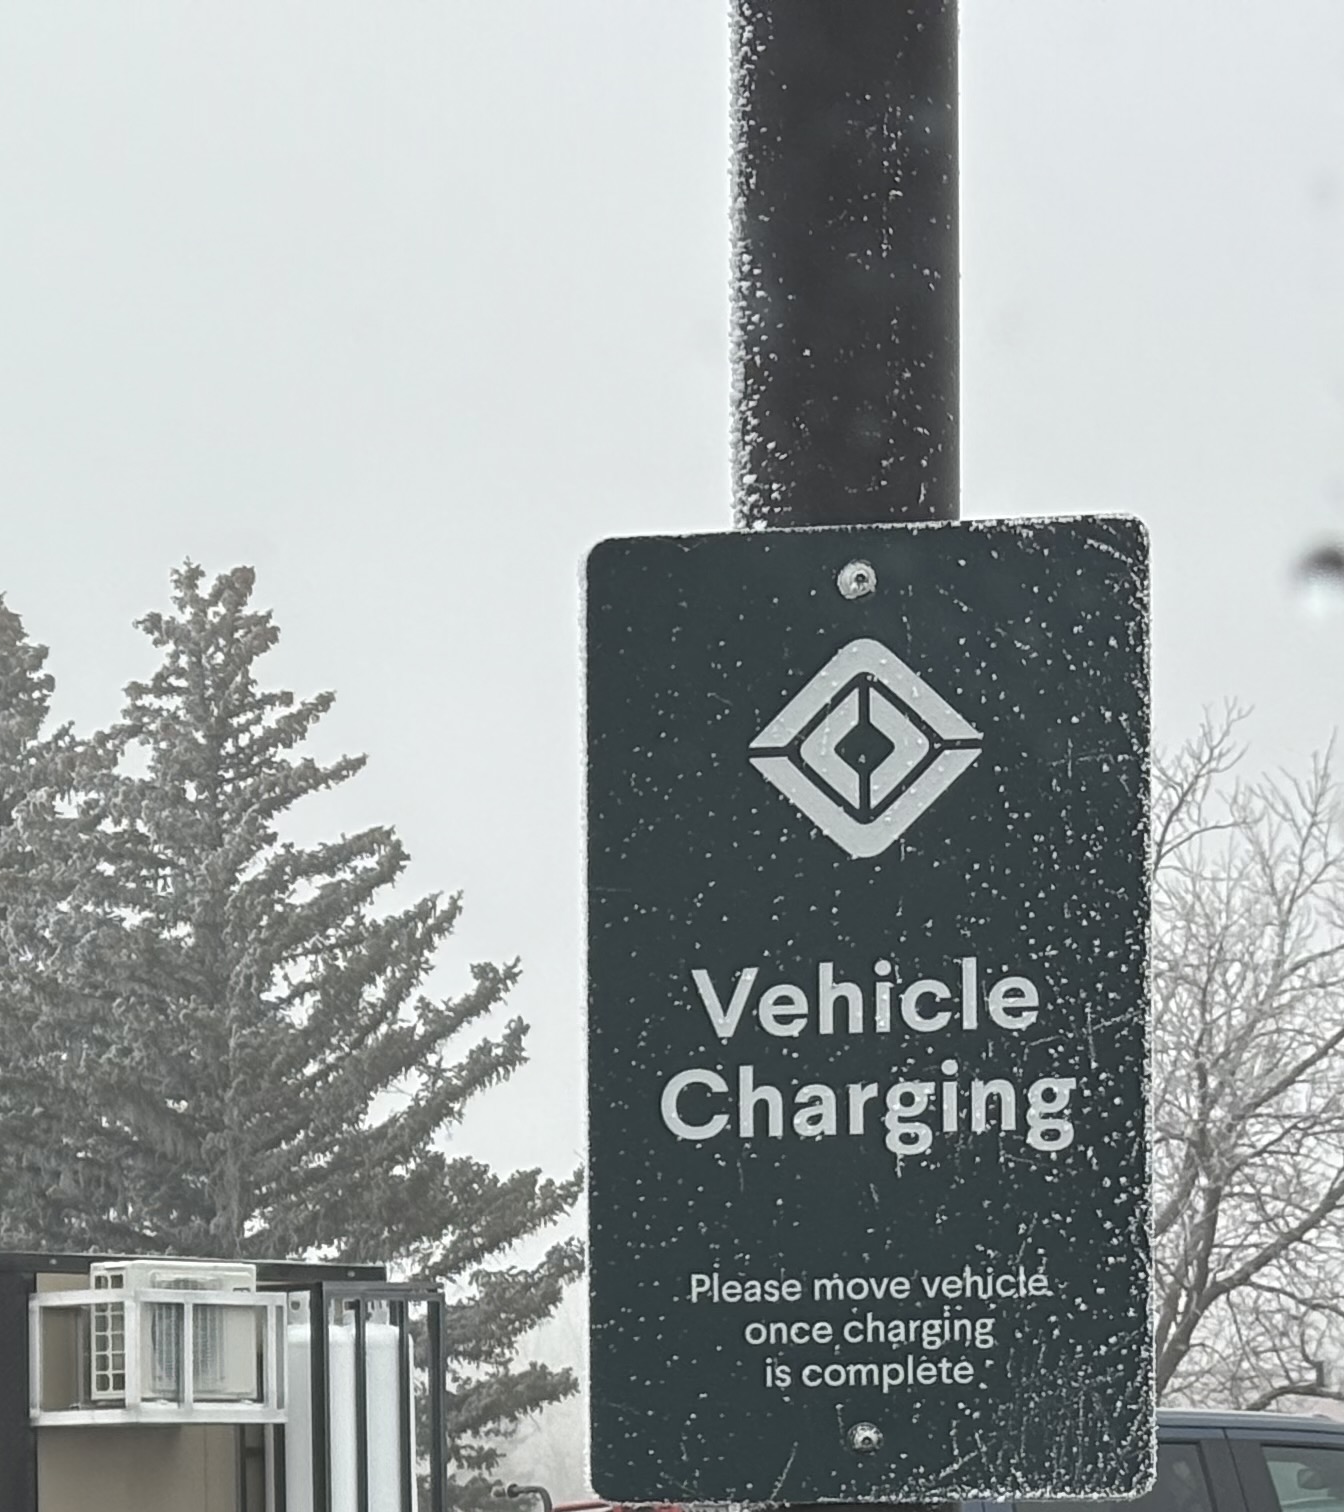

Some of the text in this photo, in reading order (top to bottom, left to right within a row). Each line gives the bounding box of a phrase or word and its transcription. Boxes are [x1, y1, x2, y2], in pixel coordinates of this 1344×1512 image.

[691, 957, 1039, 1038] Vehicle
[660, 1059, 1076, 1155] Charging
[690, 1265, 1050, 1303] Please move vehicle
[744, 1312, 996, 1350] once charging
[765, 1355, 974, 1394] is complete
